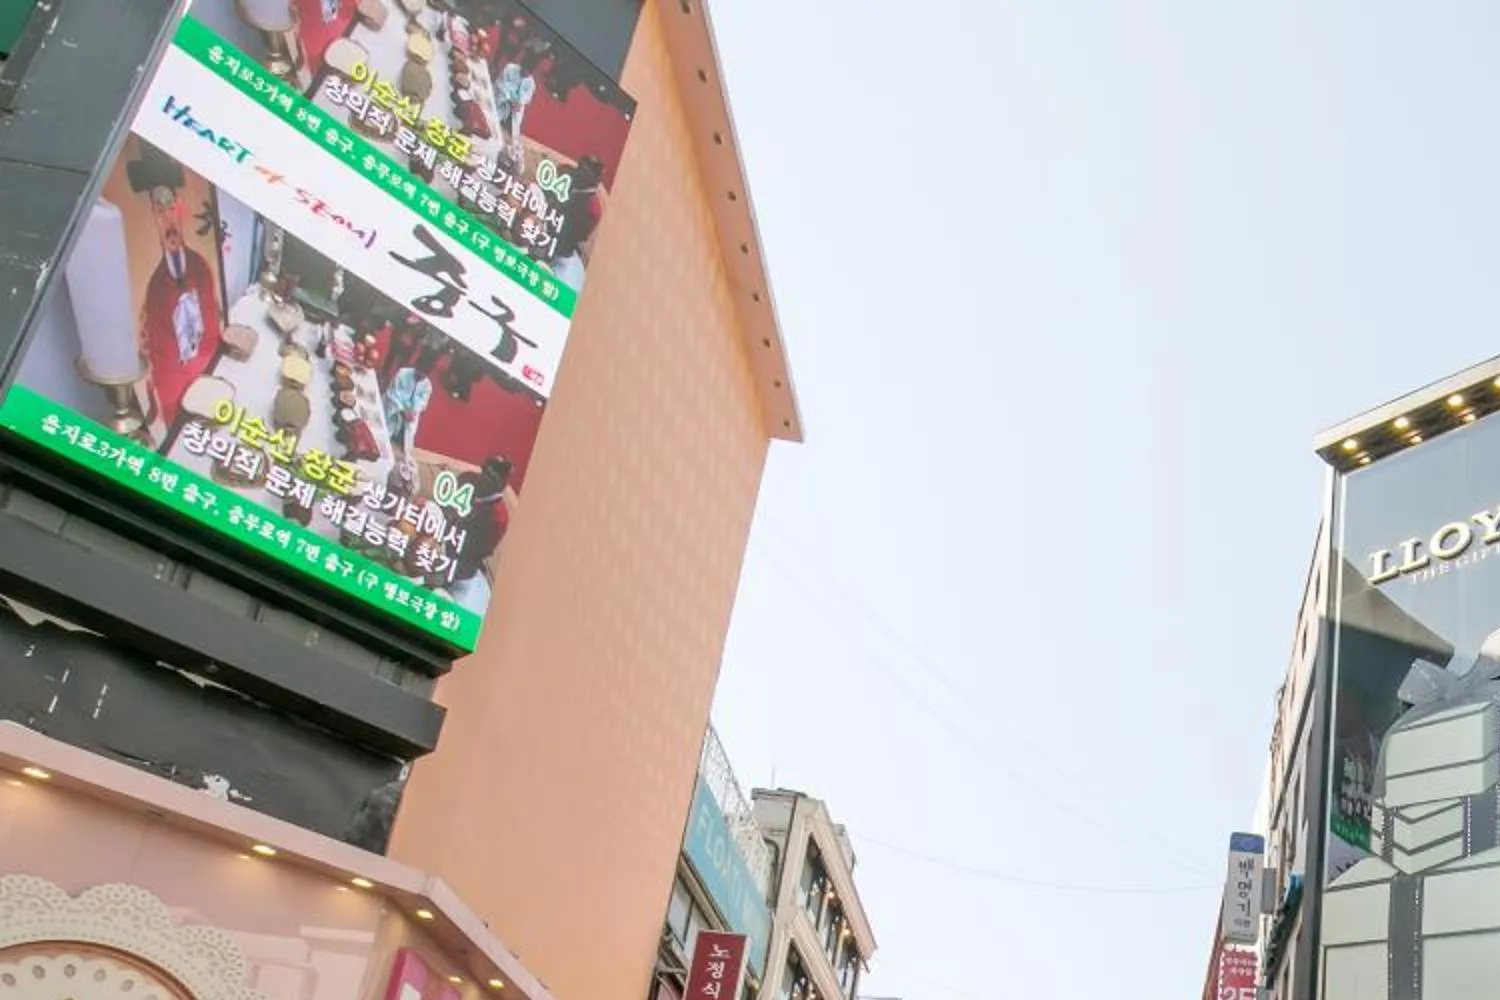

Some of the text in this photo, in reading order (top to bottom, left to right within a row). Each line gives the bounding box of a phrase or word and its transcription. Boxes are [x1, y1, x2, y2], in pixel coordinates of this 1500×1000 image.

[325, 75, 557, 257] 창의적 문제 해결능력 찾기
[351, 62, 564, 233] 이순신 장군 생가터에서
[536, 159, 572, 202] 04
[148, 466, 178, 493] 8번
[297, 538, 321, 564] 7번
[324, 554, 354, 578] 출구
[183, 420, 459, 584] 창의적 문제 해결능력 찾기
[214, 399, 467, 554] 이순신 장군 생가터에서
[433, 470, 475, 518] 04
